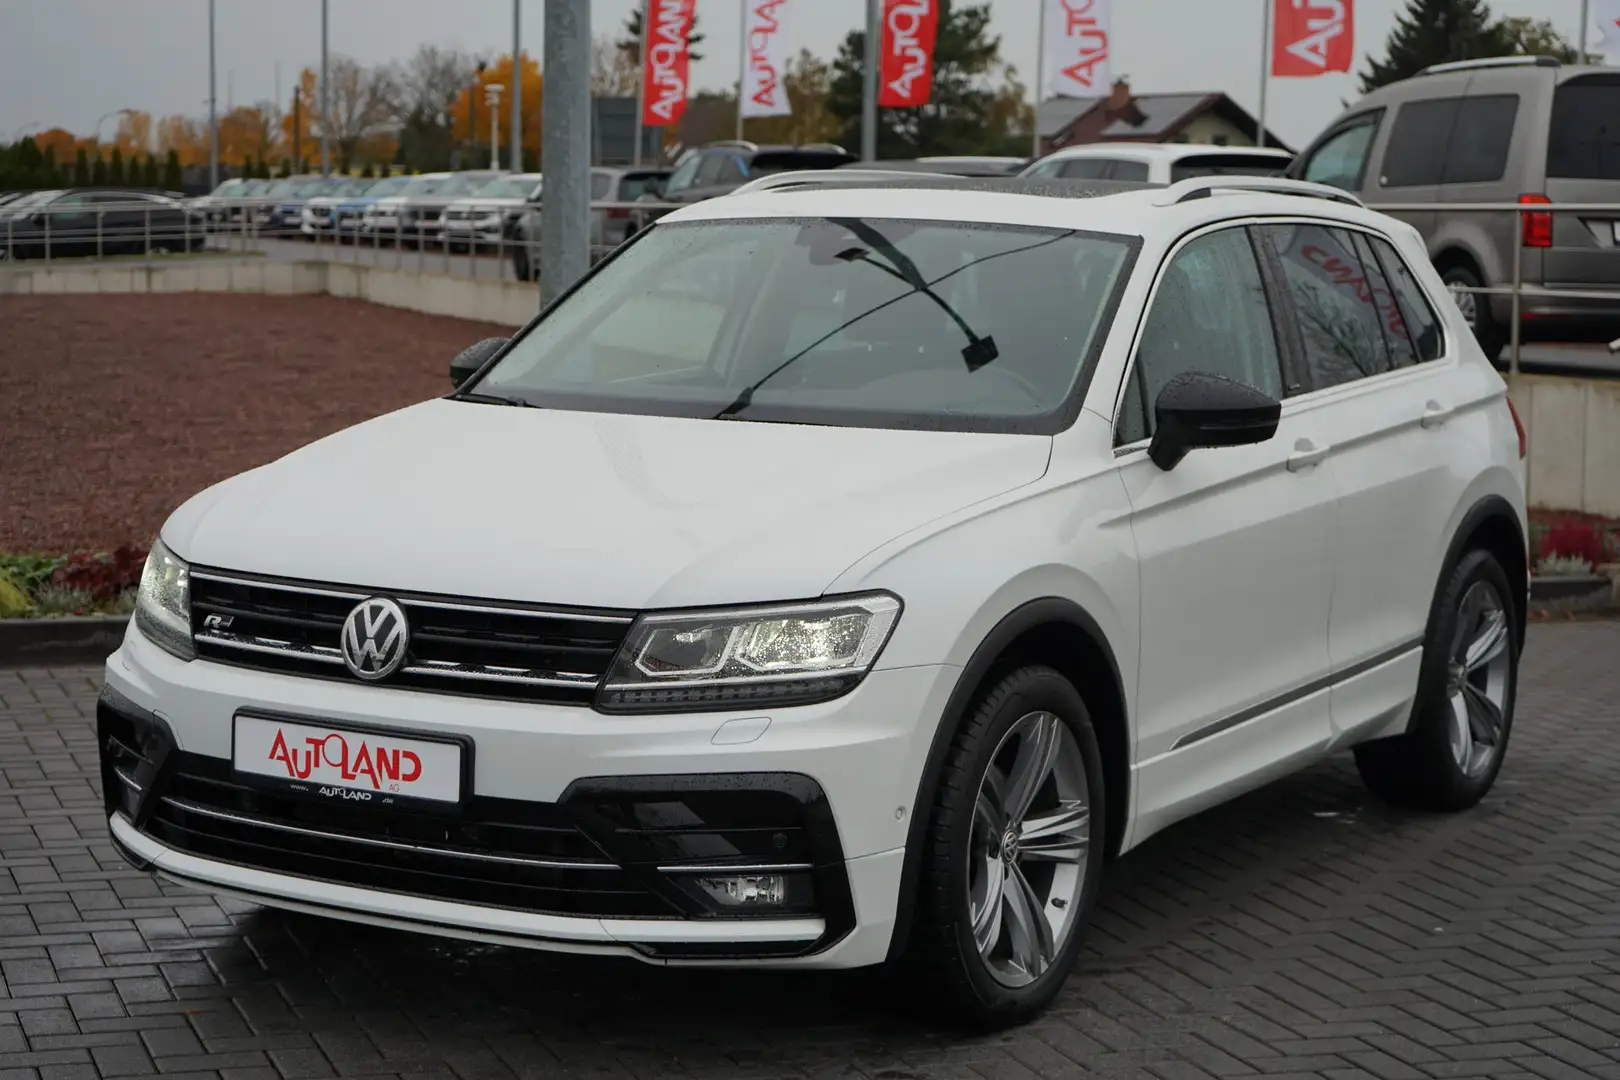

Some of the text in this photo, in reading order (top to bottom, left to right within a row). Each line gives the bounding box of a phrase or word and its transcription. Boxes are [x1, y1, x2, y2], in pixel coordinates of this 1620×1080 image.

[1284, 0, 1345, 68] AU
[268, 728, 422, 790] AUTOLAND
[319, 786, 372, 801] AUTOLAND
[388, 783, 400, 793] AG
